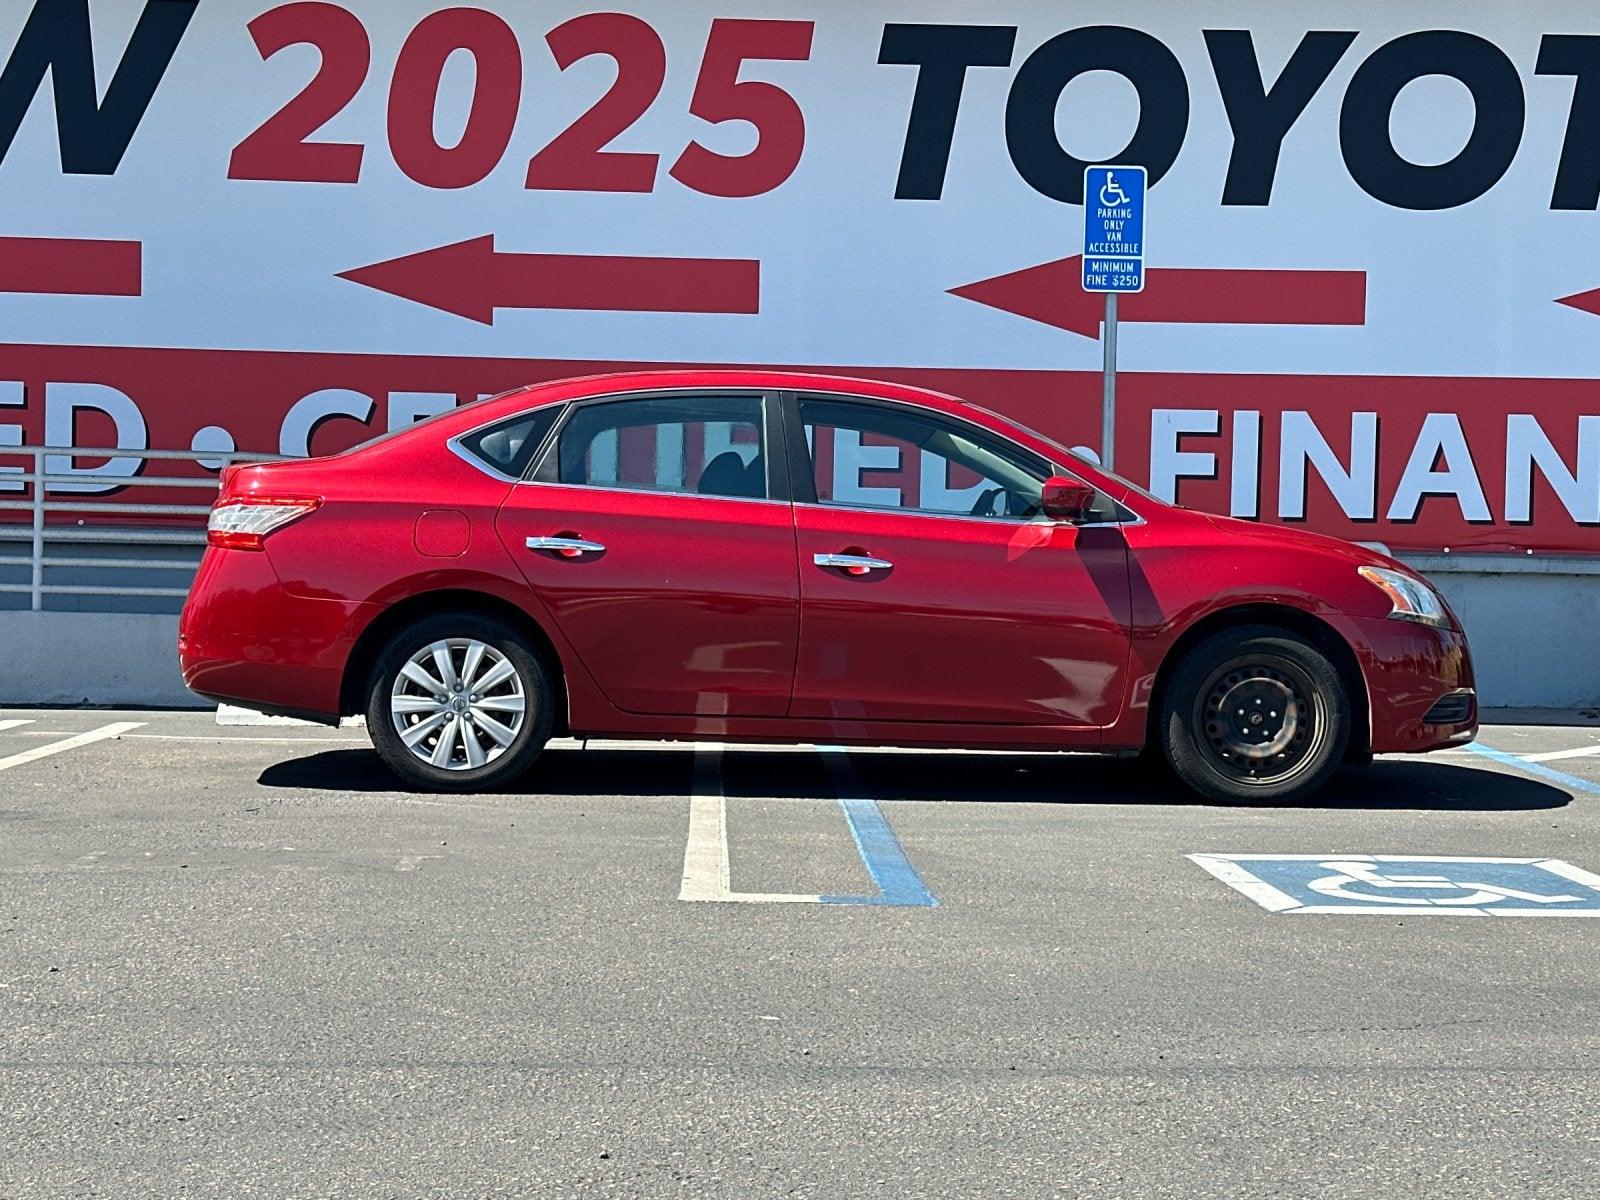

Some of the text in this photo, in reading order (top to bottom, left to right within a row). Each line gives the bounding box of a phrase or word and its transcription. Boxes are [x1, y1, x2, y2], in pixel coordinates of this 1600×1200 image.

[227, 1, 815, 198] 2025
[877, 24, 1600, 211] TOYOT
[1097, 208, 1132, 219] PARKING
[1104, 220, 1125, 230] ONLY
[1106, 231, 1122, 242] VAN
[1088, 243, 1139, 254] ACCESSIBLE
[1091, 261, 1134, 273] MINIMUM
[1086, 275, 1139, 287] FINE $250
[1149, 408, 1600, 523] FINAN
